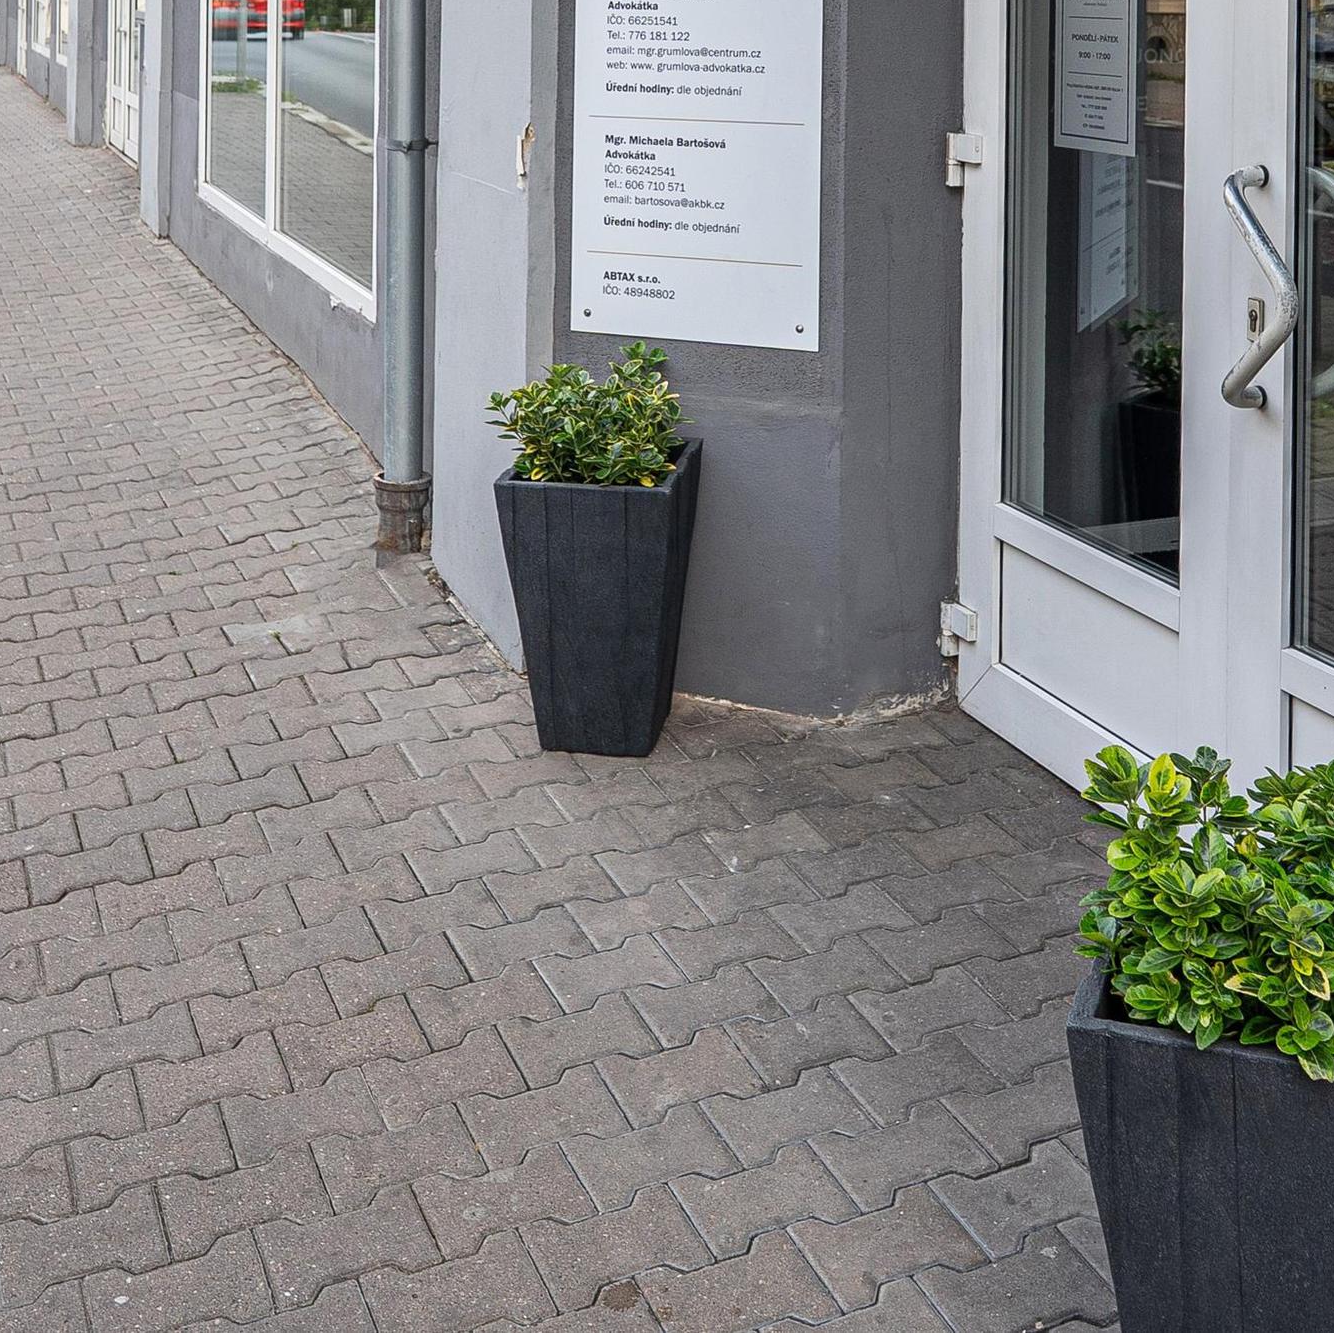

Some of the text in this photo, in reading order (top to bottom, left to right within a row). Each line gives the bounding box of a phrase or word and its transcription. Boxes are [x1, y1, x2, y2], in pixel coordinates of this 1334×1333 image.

[608, 1, 658, 10] Advokátka
[607, 14, 677, 25] IČO: 66251541
[608, 31, 689, 41] Tel.: 776 181 122
[638, 48, 761, 58] mgr.grumlova@centrum.cz
[607, 61, 627, 69] web:
[658, 63, 765, 73] grumlova-advokatka.cz
[606, 81, 742, 96] Úřední hodiny: dle objednání
[606, 135, 725, 148] Mgr. Michaela Bartošová
[606, 150, 655, 160] Advokátka
[605, 162, 675, 176] IČO: 66242541
[605, 179, 685, 192] Tel.: 606 710 571
[604, 196, 724, 209] email: bartosova@akbk.cz
[604, 215, 740, 233] Úřední hodiny: dle objednání
[604, 271, 634, 281] ABTAX
[603, 284, 675, 299] IČO: 48948802
